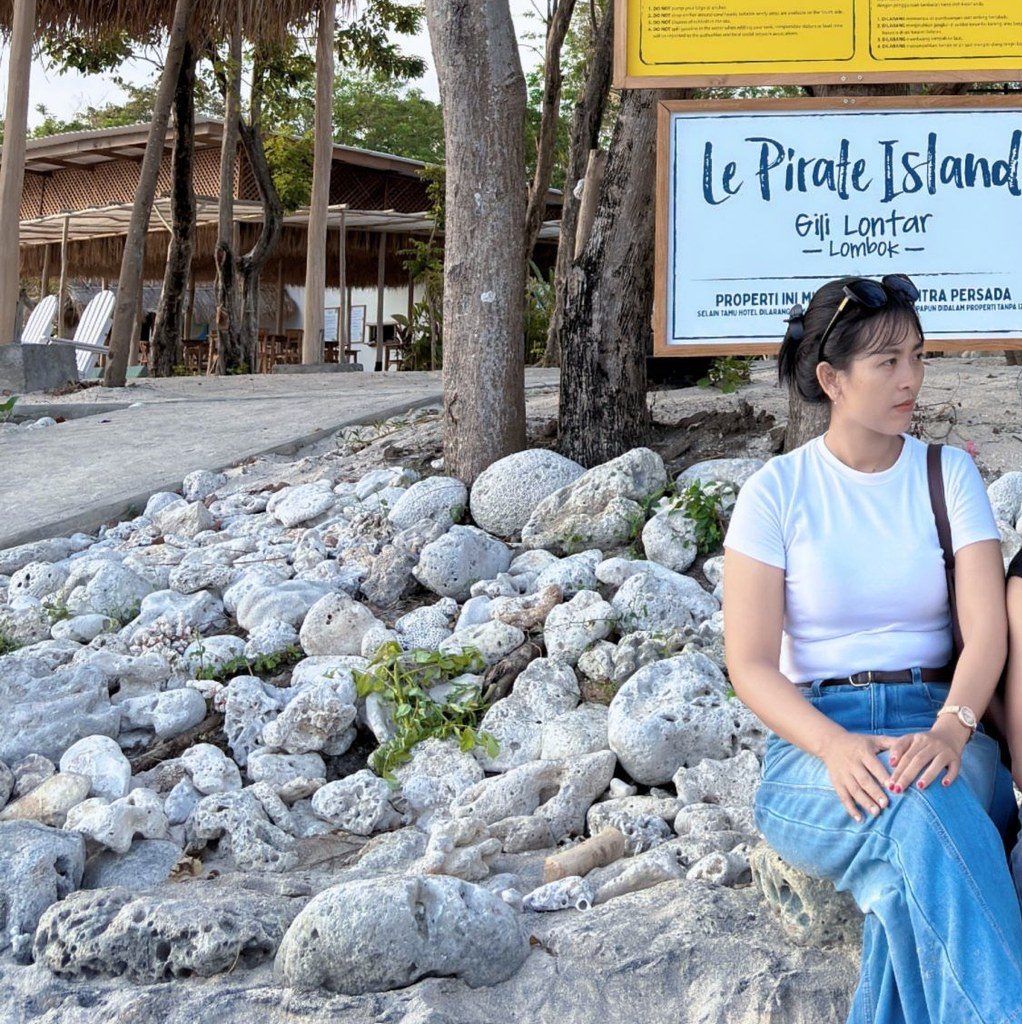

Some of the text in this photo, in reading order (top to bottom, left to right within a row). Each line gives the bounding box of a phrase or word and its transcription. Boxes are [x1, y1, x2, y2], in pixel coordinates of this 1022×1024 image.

[702, 129, 1022, 205] Le Pirate Island
[795, 209, 933, 241] Gili Lontar
[829, 236, 900, 258] Lombok
[715, 292, 779, 307] PROPERTI
[782, 291, 798, 306] INI
[918, 287, 1012, 302] ITRA PERSADA
[697, 309, 720, 318] SELAIN
[721, 309, 738, 317] TAMU
[738, 308, 757, 316] HOTEL
[938, 303, 965, 312] DIDALAM
[966, 303, 996, 312] PROPERTI
[997, 302, 1016, 311] TANPA
